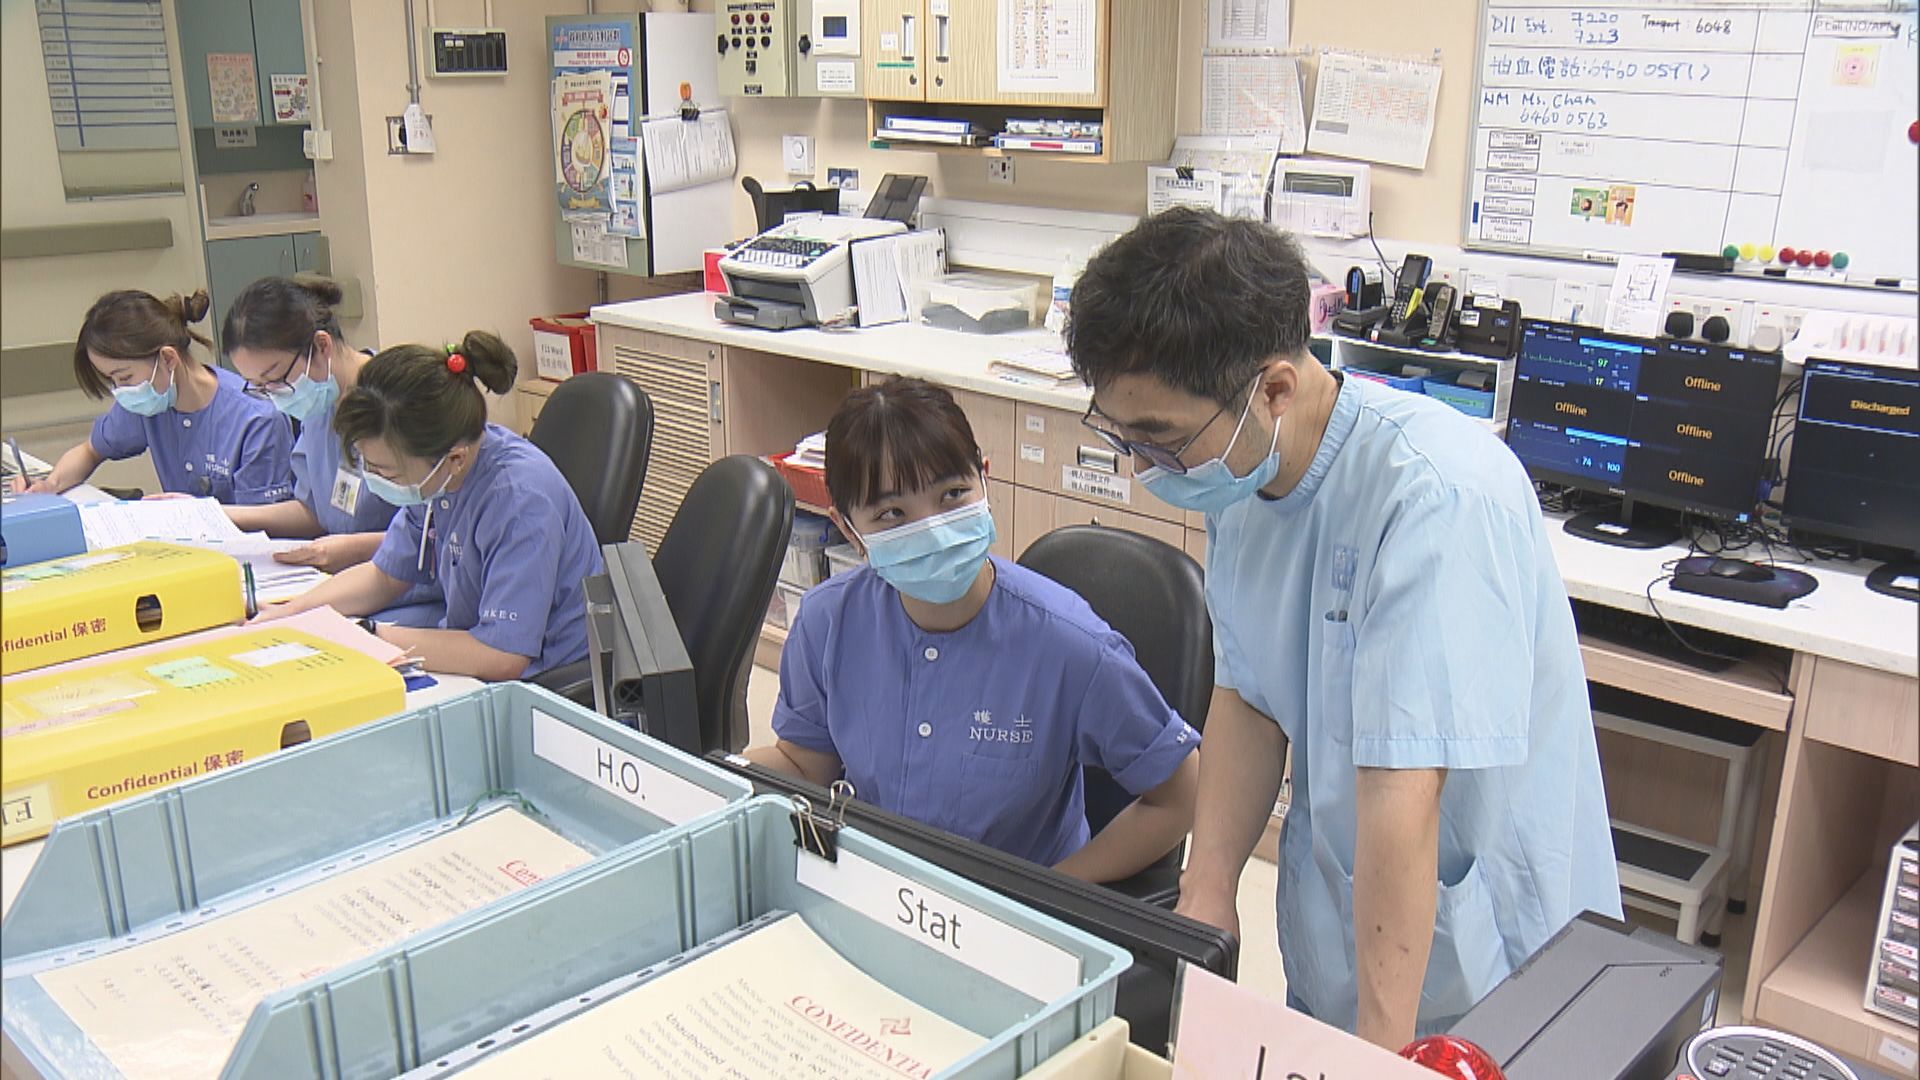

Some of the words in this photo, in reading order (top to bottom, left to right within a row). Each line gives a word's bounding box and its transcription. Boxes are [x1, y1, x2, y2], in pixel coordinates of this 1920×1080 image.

[1571, 11, 1619, 27] 7220
[1695, 18, 1732, 35] 6048
[1552, 92, 1597, 110] Chan
[1684, 375, 1722, 392] Offline
[1554, 401, 1588, 417] Offline
[1849, 399, 1911, 416] Discharged
[1676, 423, 1713, 440] Offline
[1668, 469, 1705, 487] Offline
[72, 618, 107, 638] 保密
[968, 726, 1033, 744] NURSE
[87, 761, 198, 800] Confidential
[204, 749, 245, 774] 保密
[596, 747, 646, 801] H.O.
[897, 887, 962, 950] Stat
